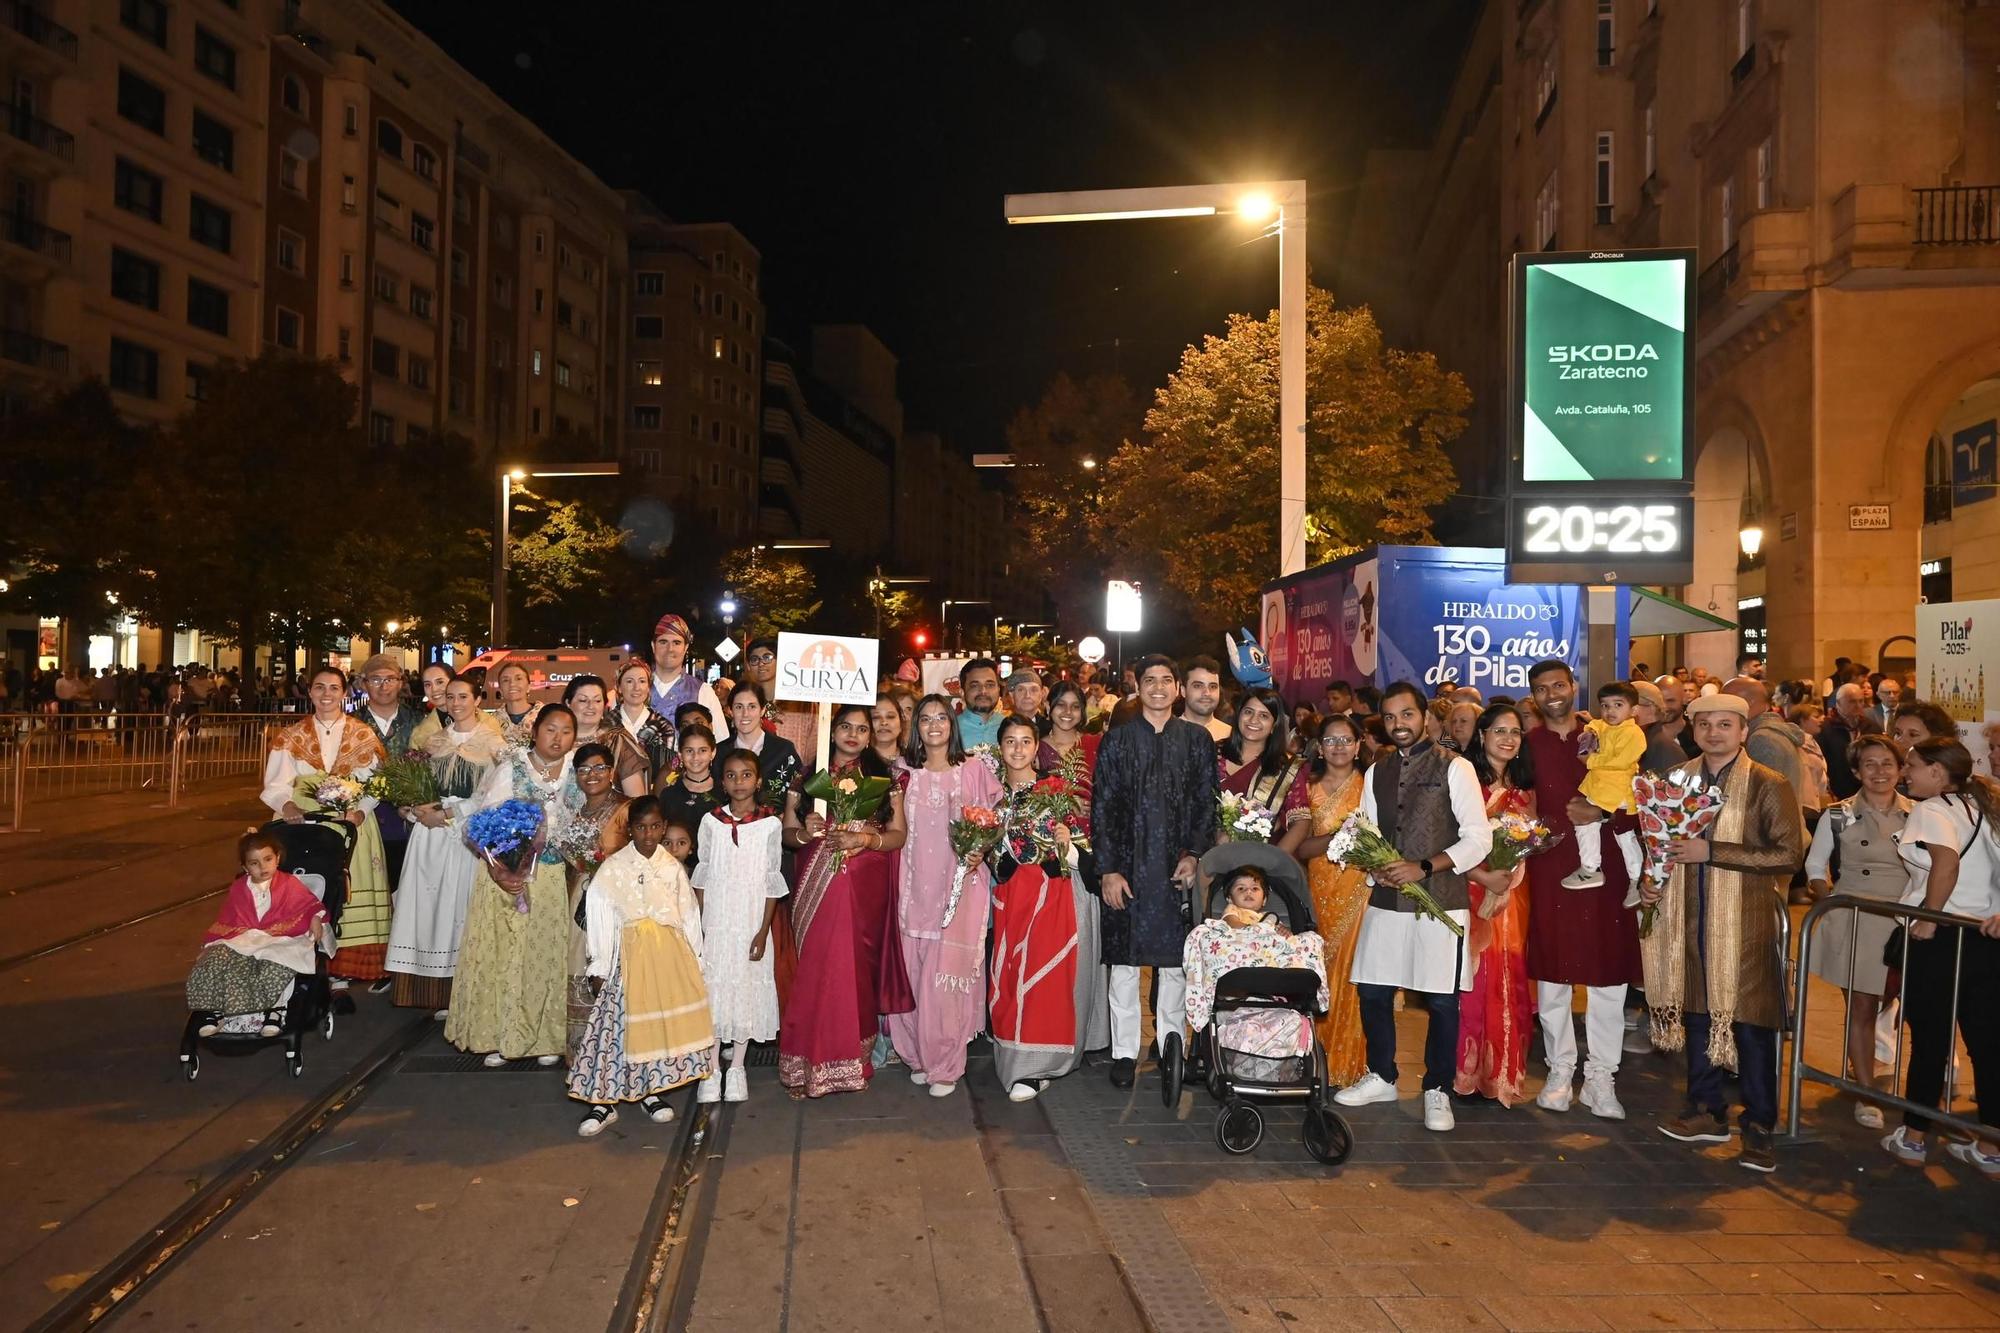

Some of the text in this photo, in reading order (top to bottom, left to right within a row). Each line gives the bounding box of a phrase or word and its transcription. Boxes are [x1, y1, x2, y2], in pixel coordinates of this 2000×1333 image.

[1559, 365, 1648, 379] Zaratecno
[1555, 404, 1651, 415] Avda. Cataluña, 105
[1526, 505, 1678, 552] 20:25
[1852, 517, 1887, 526] ESPAÑA
[1443, 602, 1536, 620] HERALDO
[1941, 621, 1969, 640] Pilar
[1297, 628, 1311, 654] 130
[1433, 625, 1569, 657] 130 años
[1304, 652, 1332, 678] Pilares
[1424, 656, 1459, 685] de
[549, 673, 573, 681] Cruz
